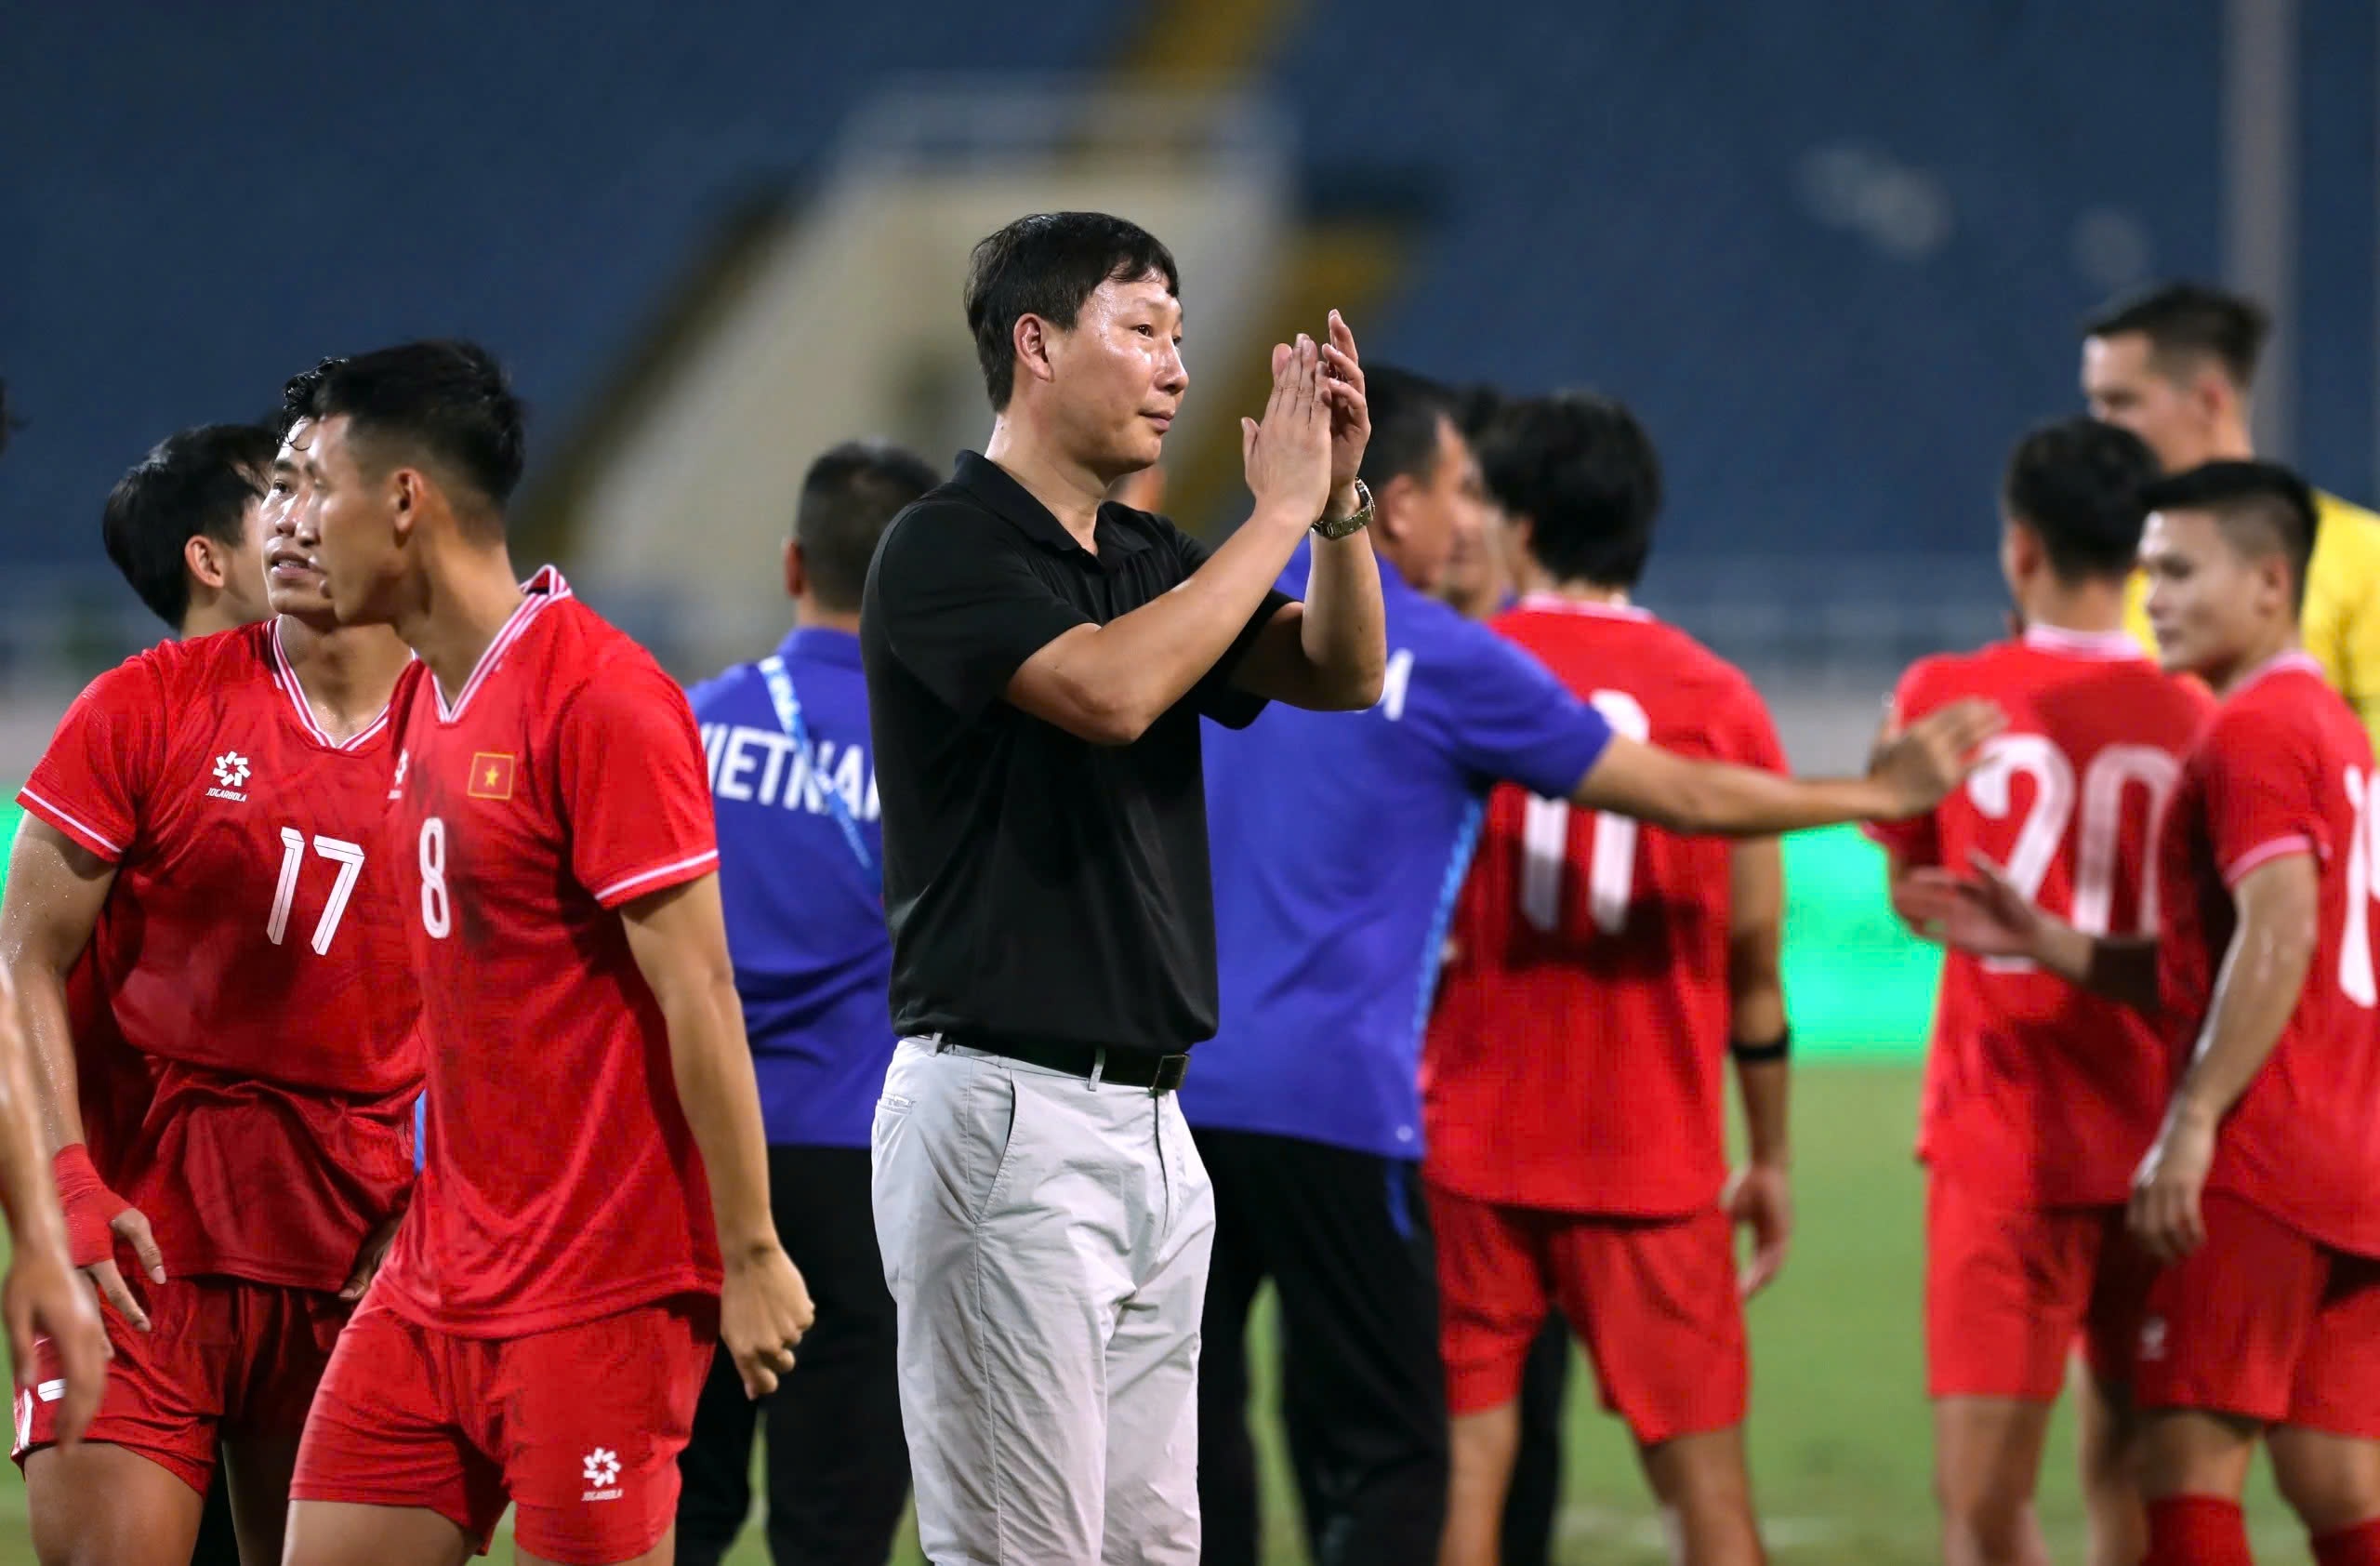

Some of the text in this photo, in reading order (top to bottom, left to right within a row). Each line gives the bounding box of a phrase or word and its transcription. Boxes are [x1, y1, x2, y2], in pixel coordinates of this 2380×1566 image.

[266, 826, 365, 956] 17
[419, 816, 451, 939] 8
[1964, 734, 2181, 975] 20
[2337, 768, 2380, 1008] 1
